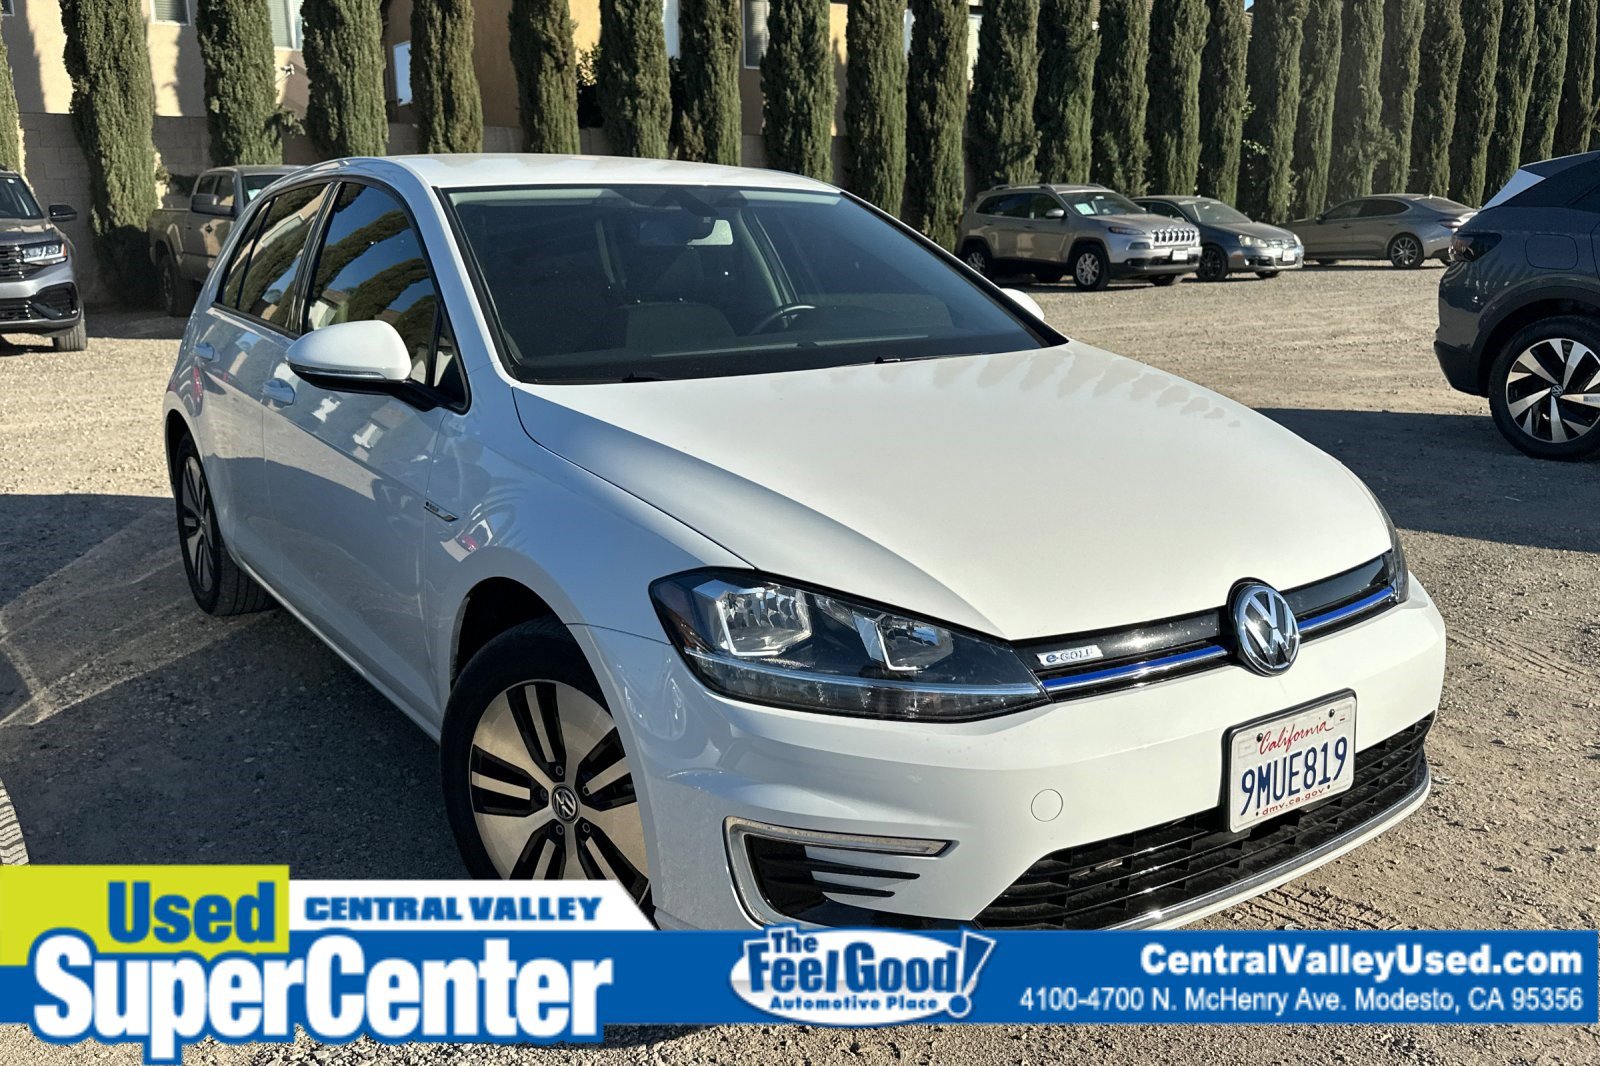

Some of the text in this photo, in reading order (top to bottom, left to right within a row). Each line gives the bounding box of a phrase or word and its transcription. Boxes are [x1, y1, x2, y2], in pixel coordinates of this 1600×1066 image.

[1260, 720, 1334, 755] California
[1240, 736, 1348, 816] 9MUE819
[1262, 787, 1325, 816] dmv.ca.gov
